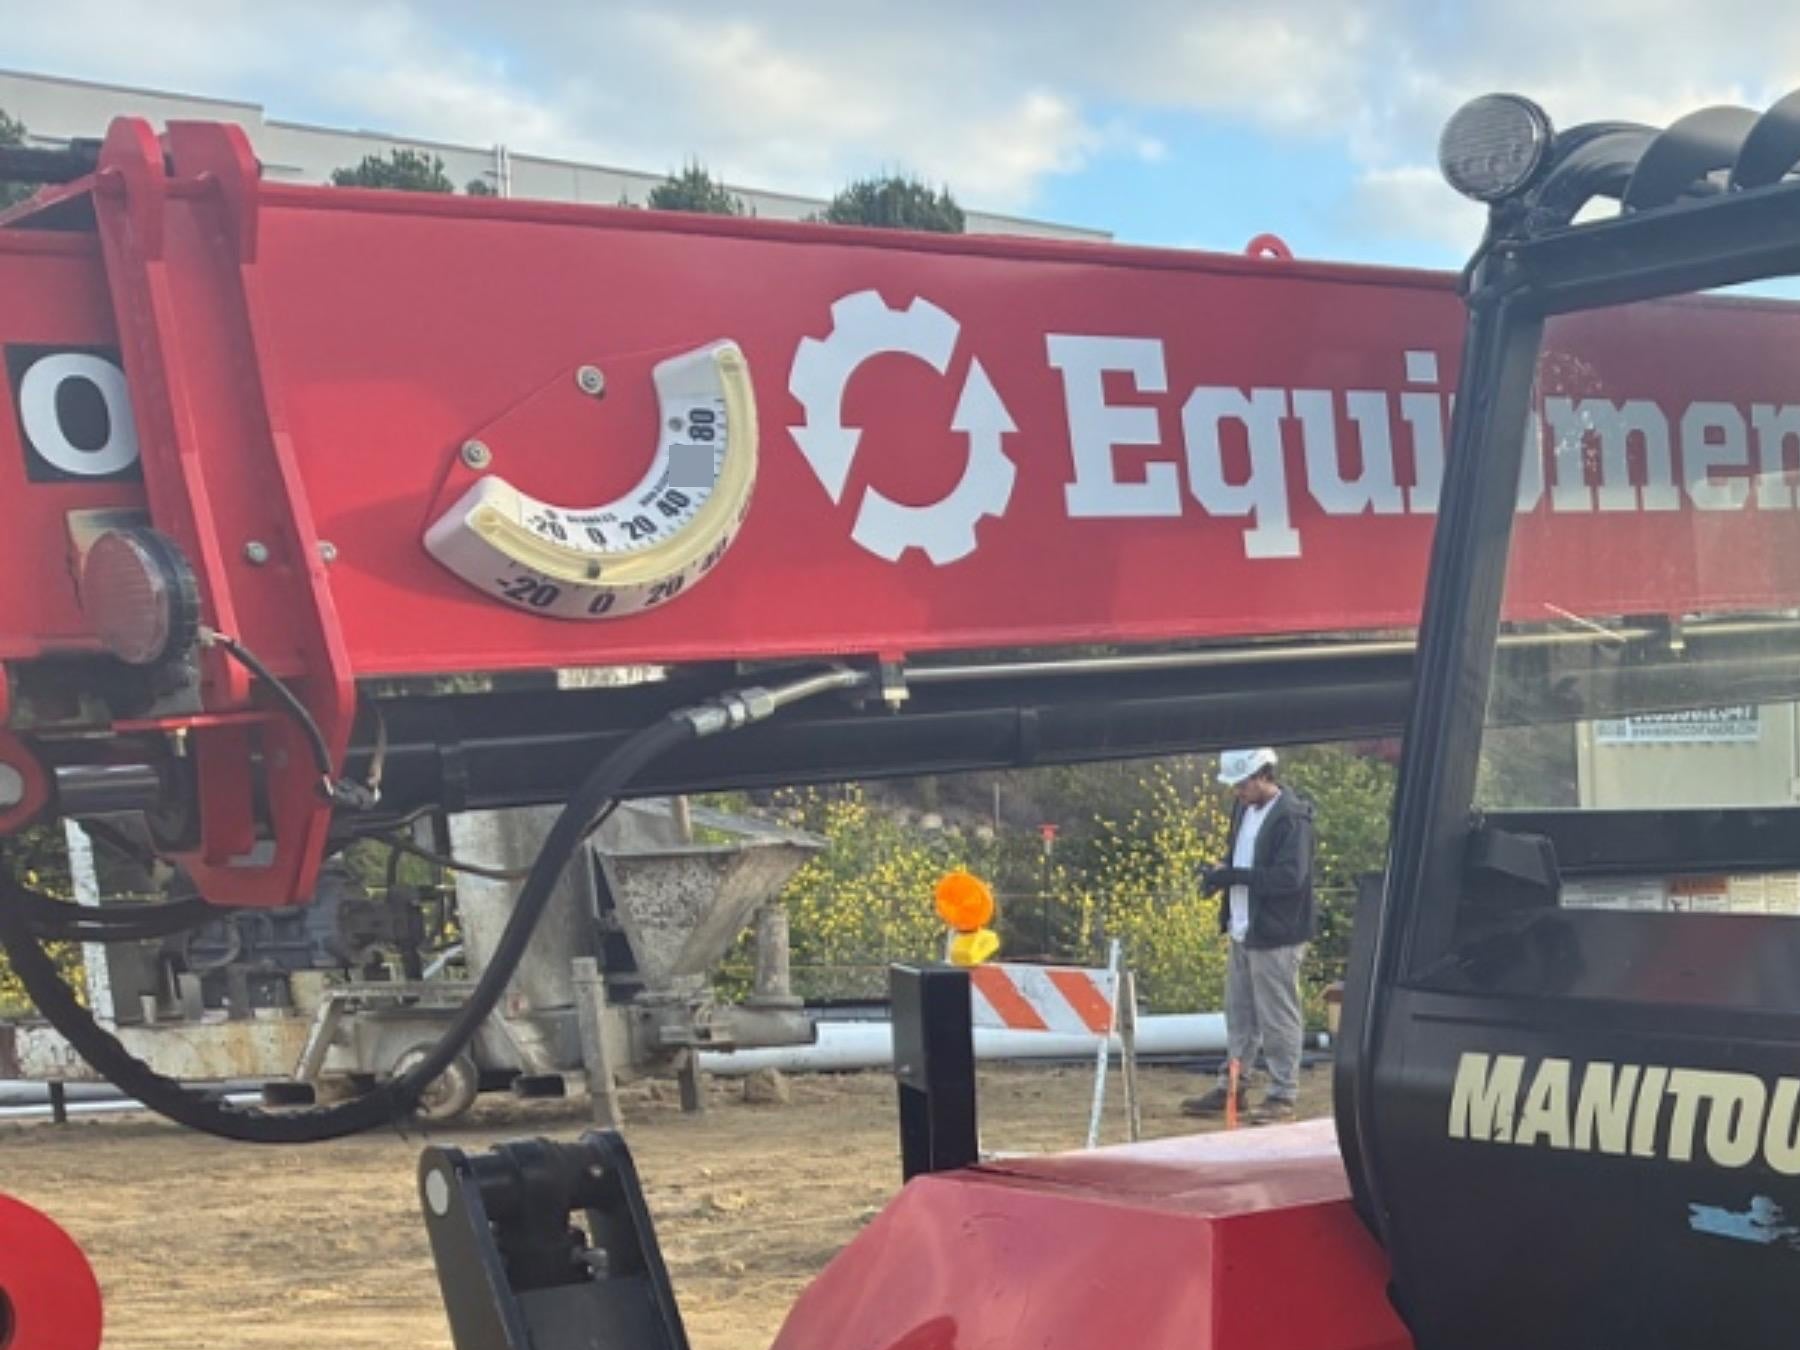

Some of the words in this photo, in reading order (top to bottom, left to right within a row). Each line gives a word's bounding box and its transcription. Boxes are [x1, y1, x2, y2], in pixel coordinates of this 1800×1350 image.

[620, 515, 658, 541] 20
[656, 489, 691, 519] 40
[688, 408, 715, 442] 80
[495, 575, 559, 608] -20
[588, 593, 616, 614] 0
[645, 574, 685, 607] 20
